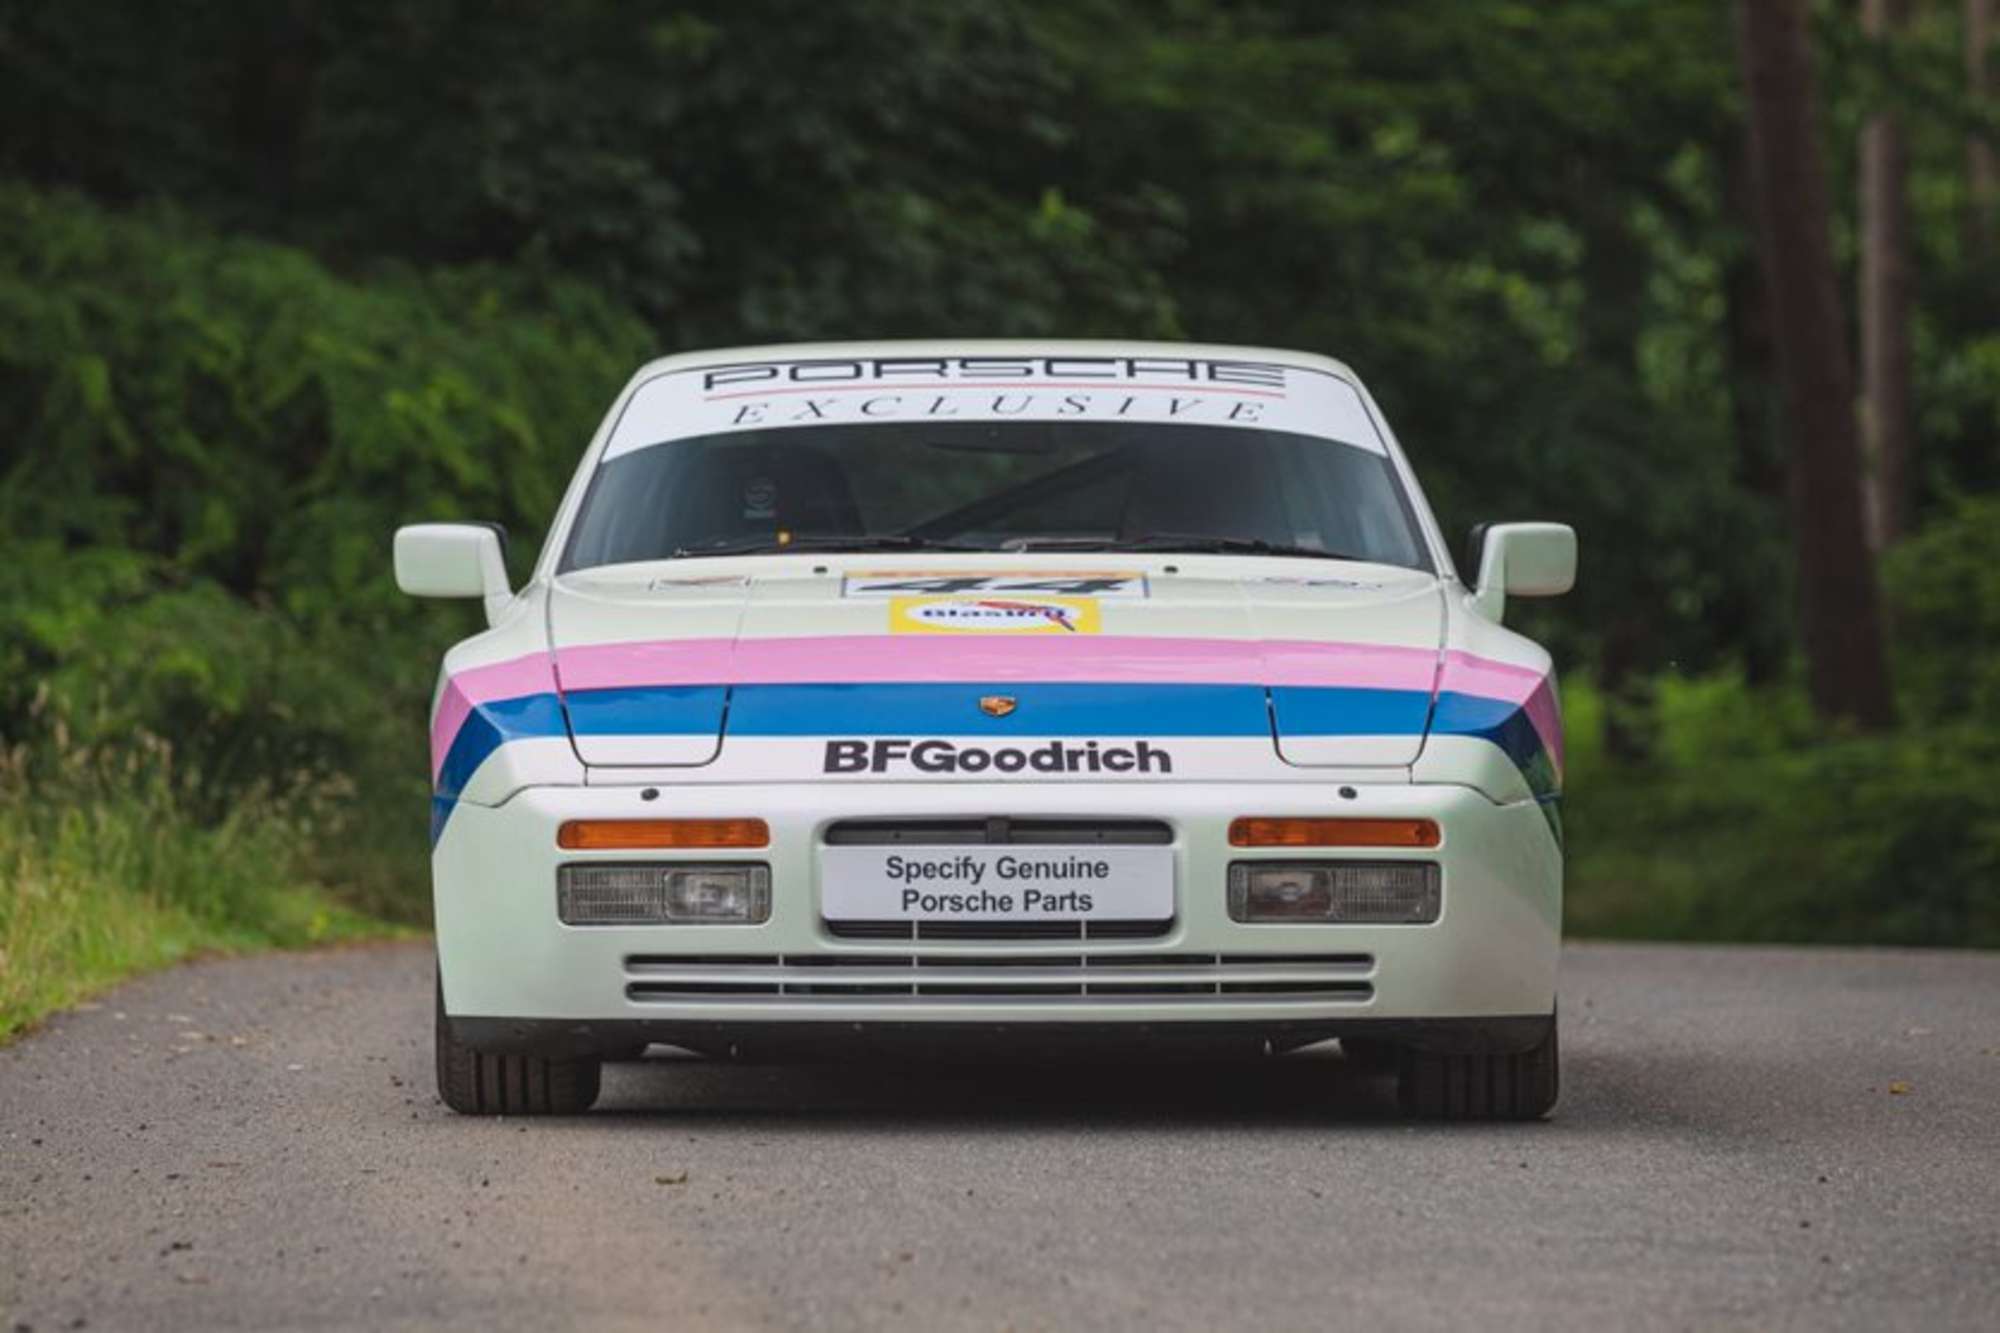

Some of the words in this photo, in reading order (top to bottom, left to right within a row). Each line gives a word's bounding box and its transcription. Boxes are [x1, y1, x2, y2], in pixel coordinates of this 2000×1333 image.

[704, 357, 1286, 390] PORSCHE
[732, 396, 1265, 425] EXCLUSIVE
[857, 576, 1132, 594] 44
[823, 739, 1173, 774] BFGoodrich
[885, 856, 987, 884] Specify
[996, 856, 1110, 880] Genuine
[902, 888, 1014, 912] Porsche
[1023, 889, 1094, 912] Parts
